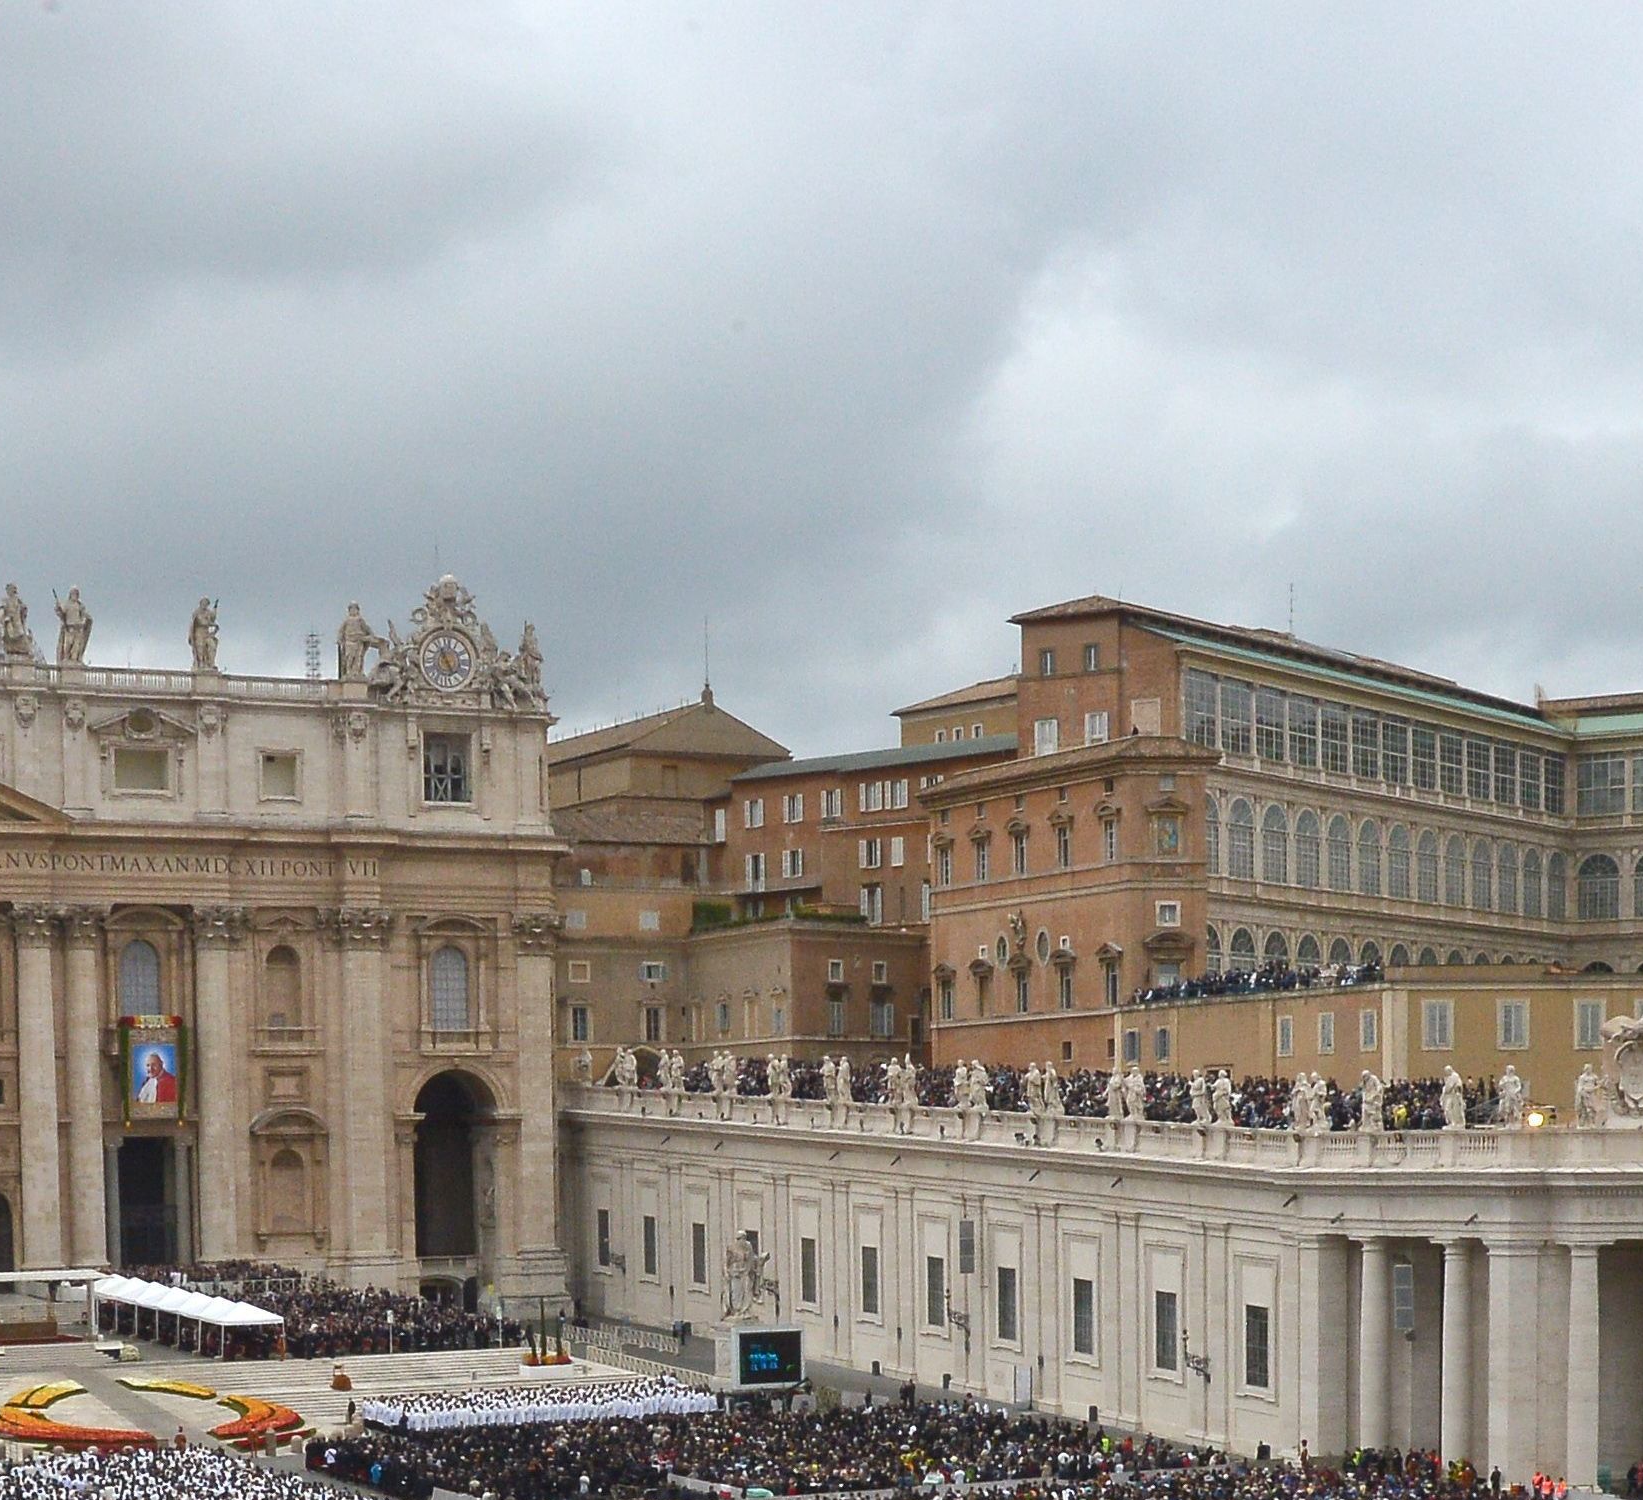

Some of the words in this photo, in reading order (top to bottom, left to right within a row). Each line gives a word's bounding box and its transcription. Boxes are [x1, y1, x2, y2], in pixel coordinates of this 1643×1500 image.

[50, 854, 109, 872] PONT
[109, 856, 157, 873] MAX
[161, 856, 190, 873] AN
[195, 856, 275, 875] MDCXII
[281, 858, 336, 876] PONT
[348, 859, 378, 877] VII
